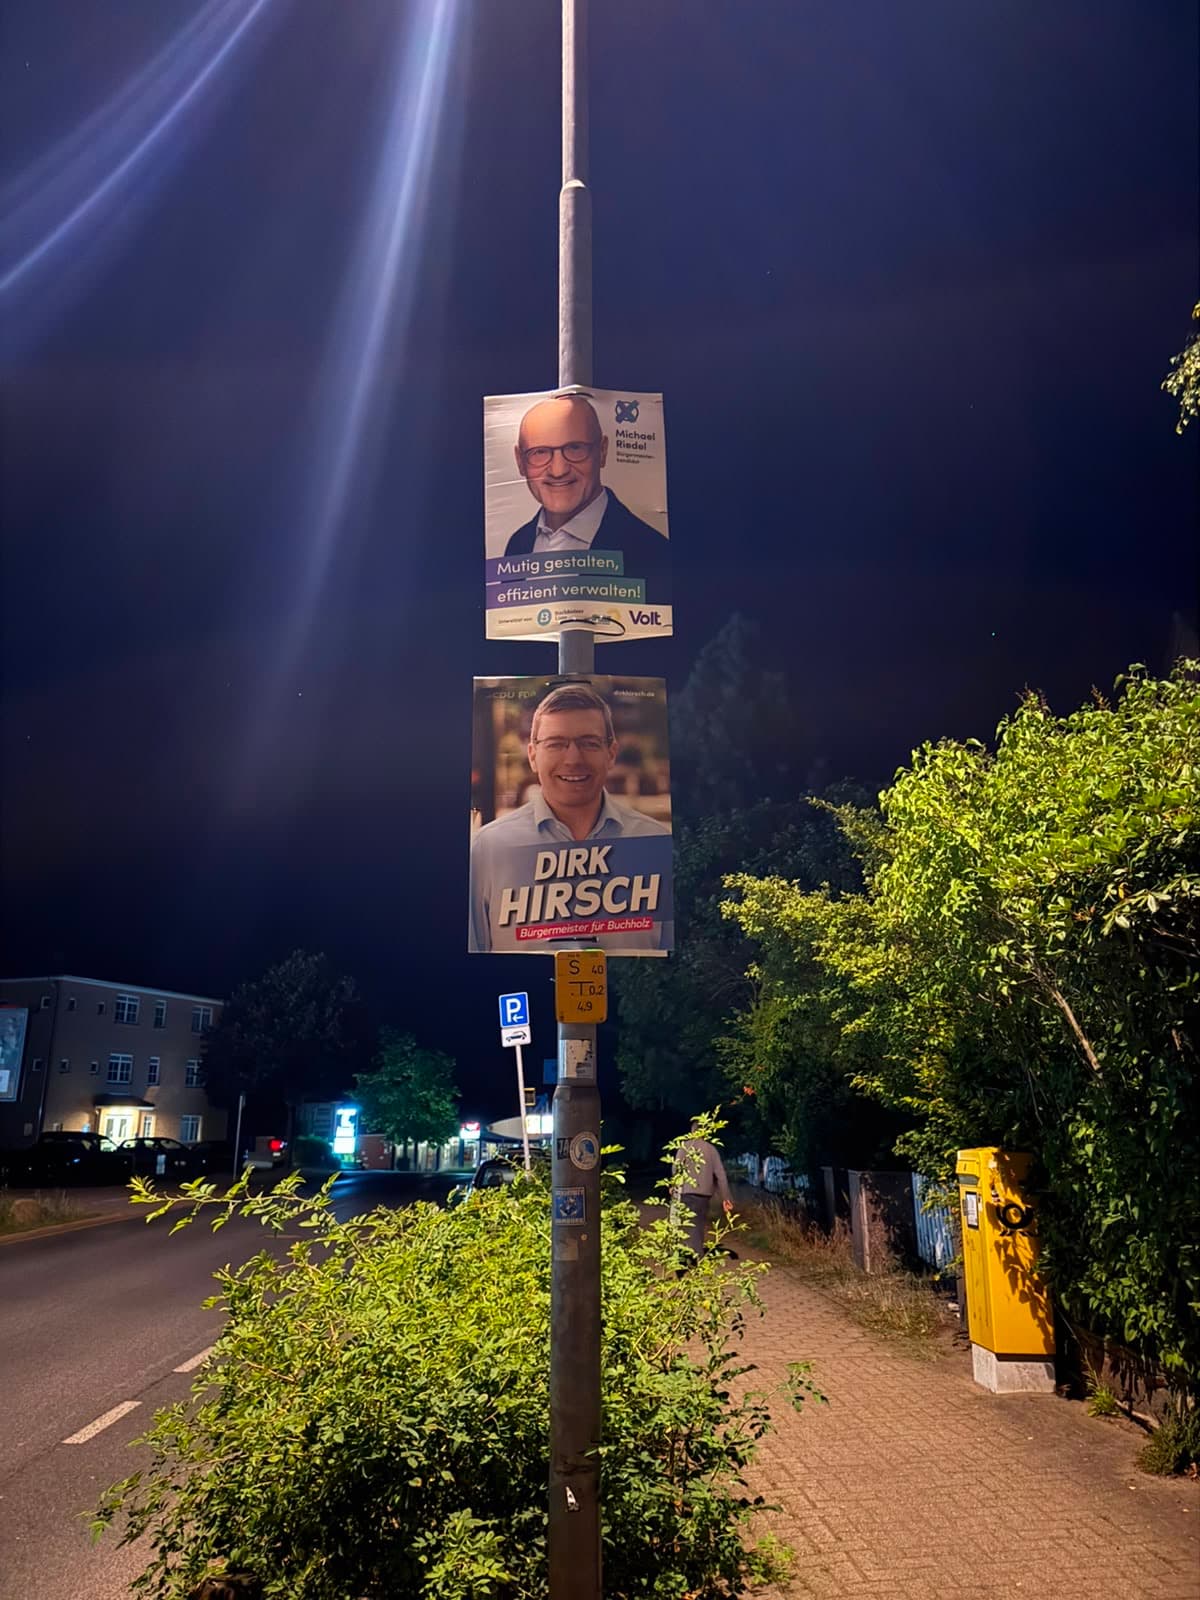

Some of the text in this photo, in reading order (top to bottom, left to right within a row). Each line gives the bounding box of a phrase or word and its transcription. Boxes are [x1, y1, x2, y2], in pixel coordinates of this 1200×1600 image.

[615, 429, 656, 441] Michael
[616, 440, 647, 451] Riedel
[497, 554, 619, 575] Mutig gestalten,
[497, 583, 641, 603] effizient verwalten!
[629, 610, 662, 626] Volt
[534, 845, 612, 881] DIRK
[498, 874, 661, 926] HIRSCH
[520, 917, 650, 938] Bürgermeister für Buchholz
[569, 959, 580, 975] S
[506, 998, 521, 1023] P
